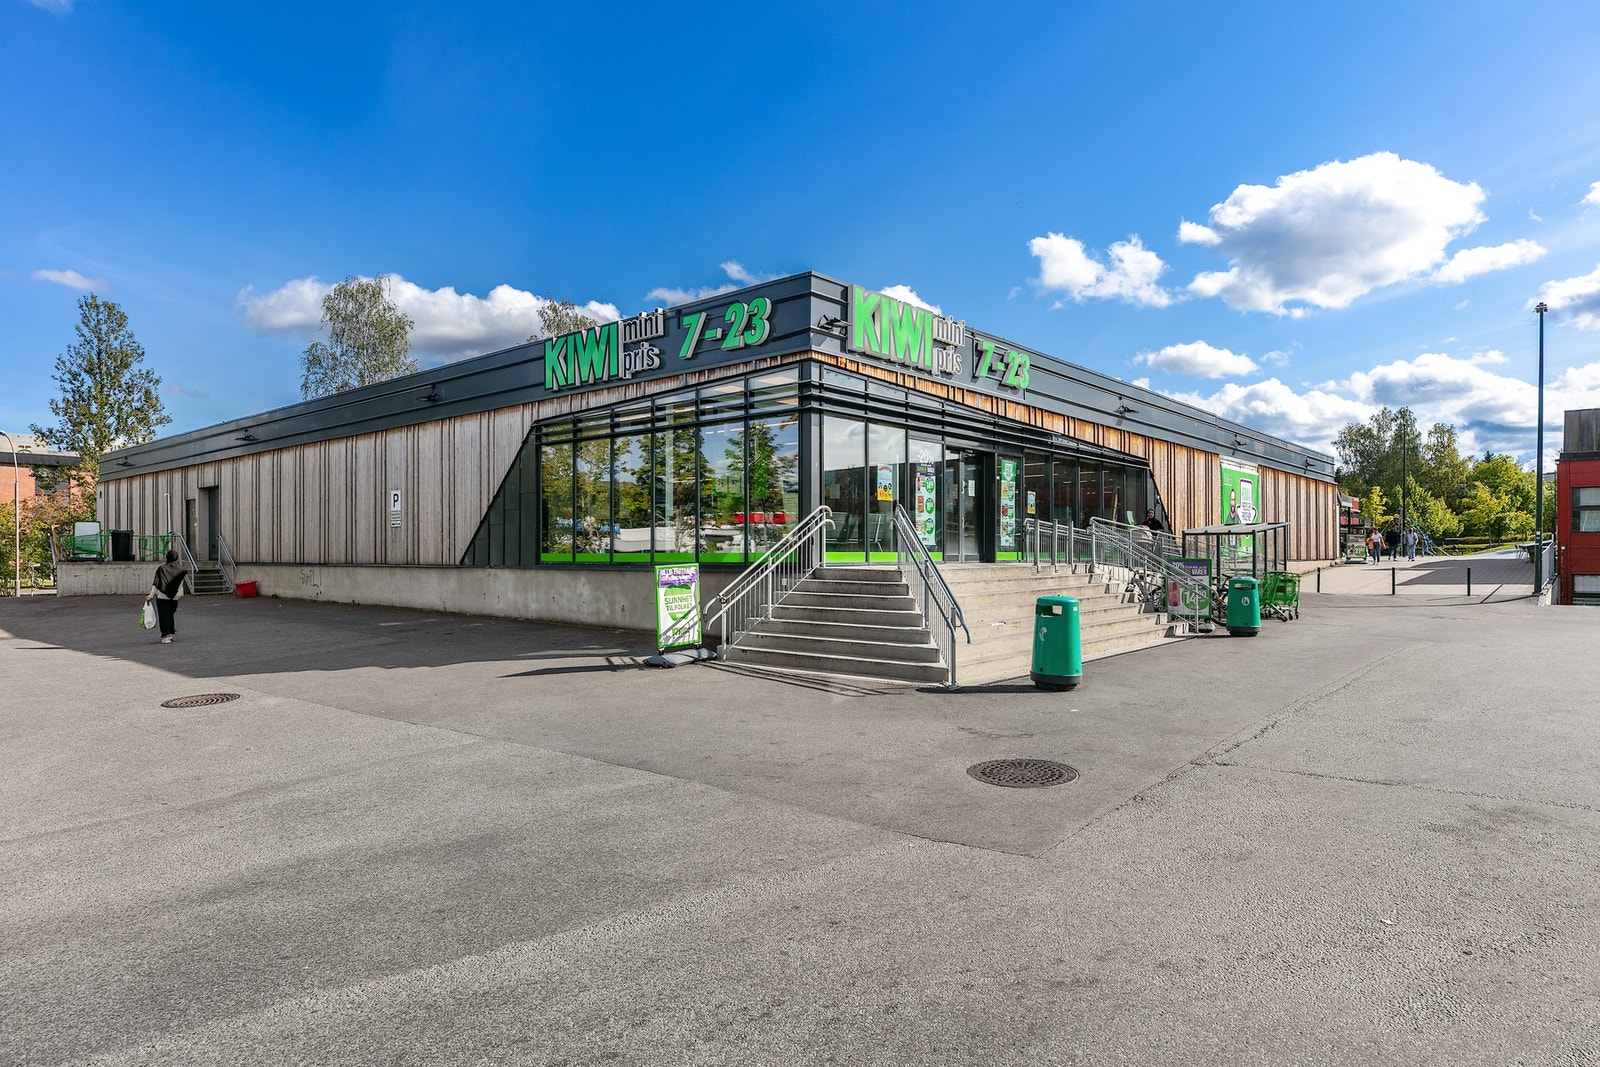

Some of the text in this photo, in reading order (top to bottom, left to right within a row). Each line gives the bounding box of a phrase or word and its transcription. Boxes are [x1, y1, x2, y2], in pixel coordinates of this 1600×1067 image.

[623, 308, 663, 343] mini
[850, 284, 934, 371] KIWI
[934, 315, 966, 347] mini
[544, 322, 619, 391] KIWI
[623, 342, 660, 379] pris
[933, 345, 963, 377] pris
[975, 340, 1031, 389] 7-23
[393, 493, 399, 508] P
[664, 595, 693, 606] SUNNHET
[665, 602, 693, 613] TIL FOLKET
